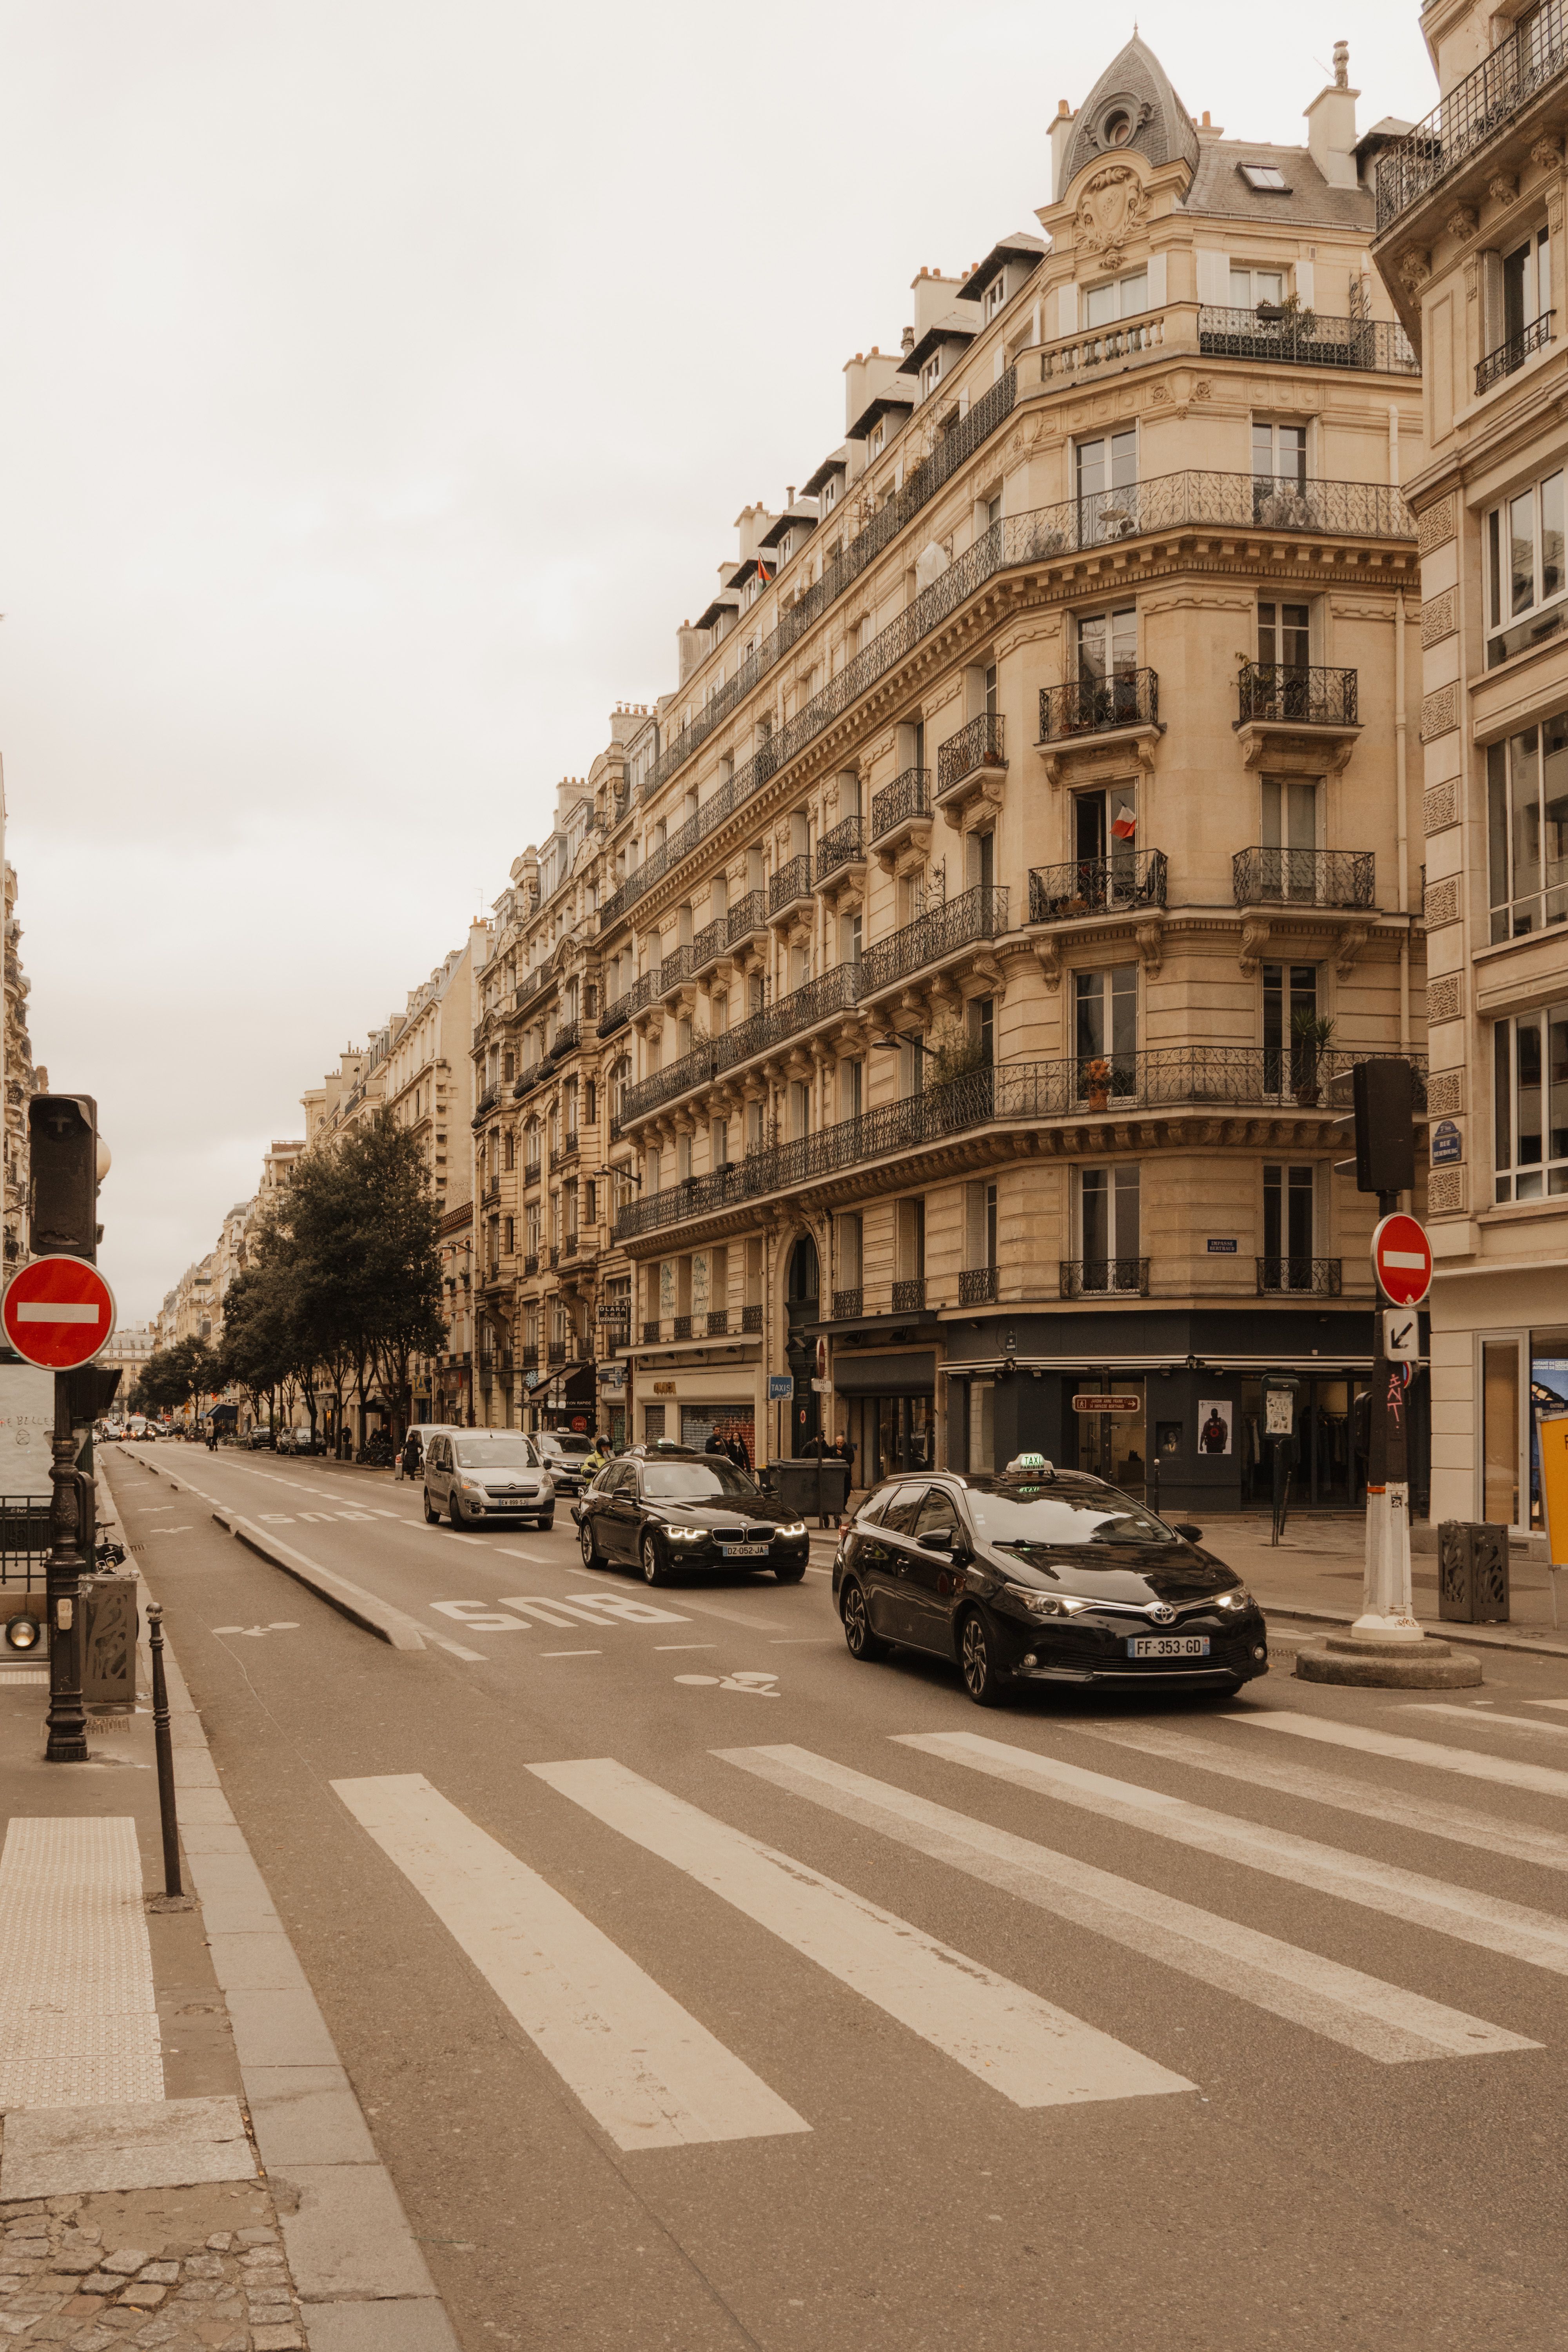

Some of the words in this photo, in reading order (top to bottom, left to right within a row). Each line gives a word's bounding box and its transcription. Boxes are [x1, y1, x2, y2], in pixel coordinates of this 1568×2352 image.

[1024, 1456, 1041, 1465] TAXI
[258, 1511, 379, 1523] BUS
[429, 1593, 694, 1630] BUS
[1137, 1640, 1200, 1655] FF-353-GD
